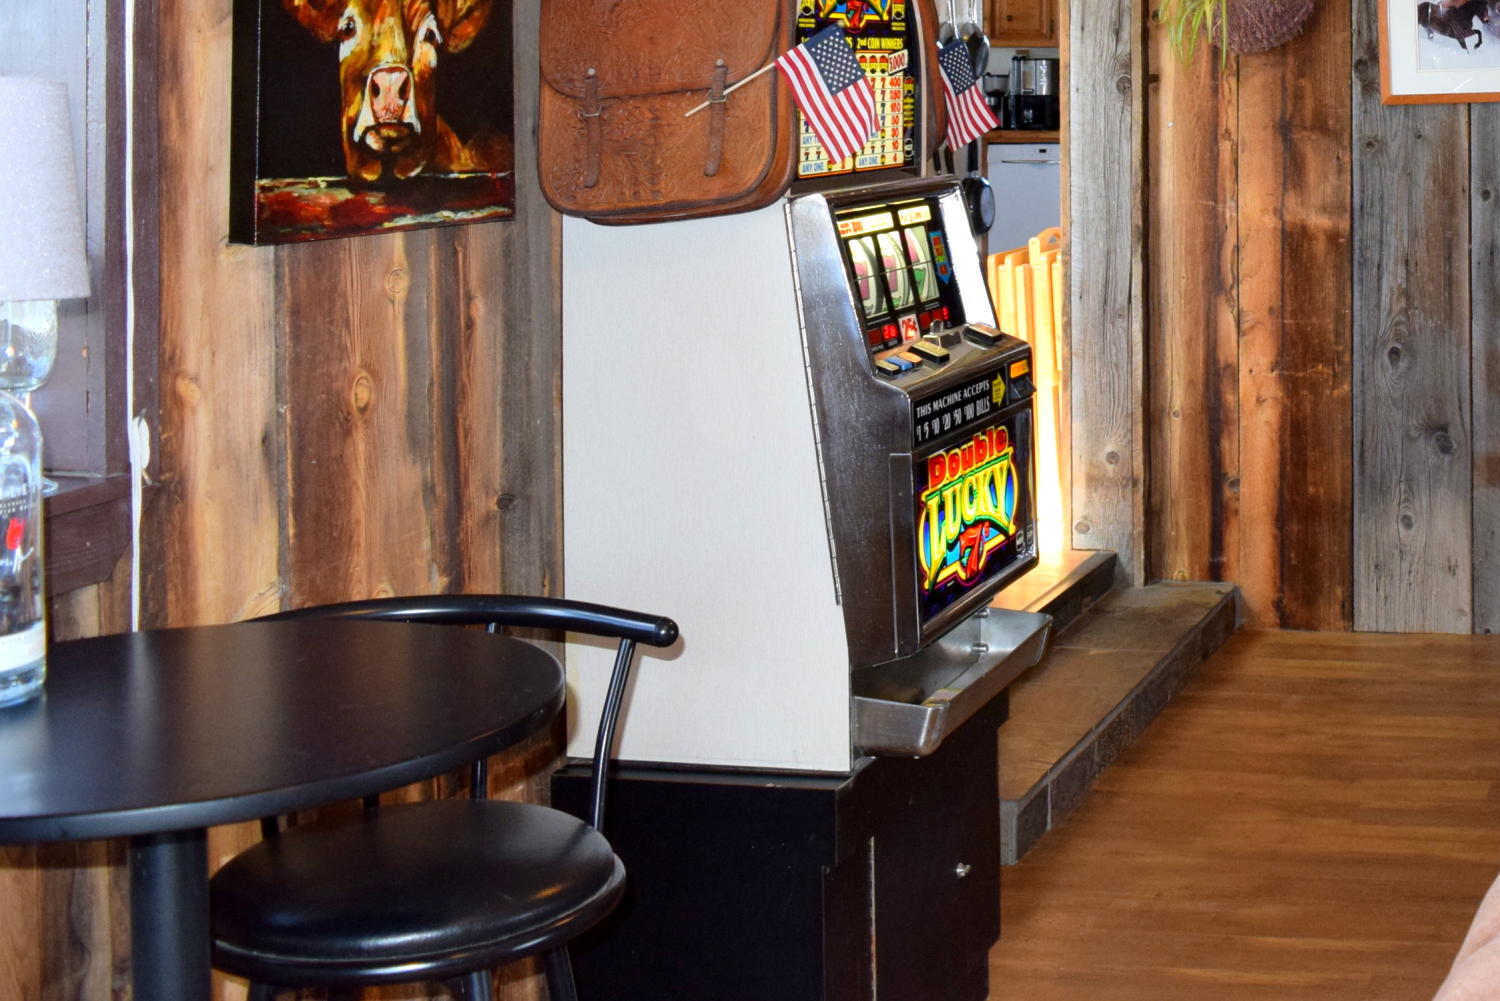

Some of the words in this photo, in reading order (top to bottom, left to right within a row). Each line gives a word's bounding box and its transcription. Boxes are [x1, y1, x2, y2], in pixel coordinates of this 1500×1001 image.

[916, 403, 932, 418] THIS
[933, 390, 961, 412] MACHINE
[963, 380, 990, 399] ACCEPTS
[976, 396, 990, 416] BILLS
[928, 426, 1008, 489] Double
[926, 460, 1011, 592] LUCKY
